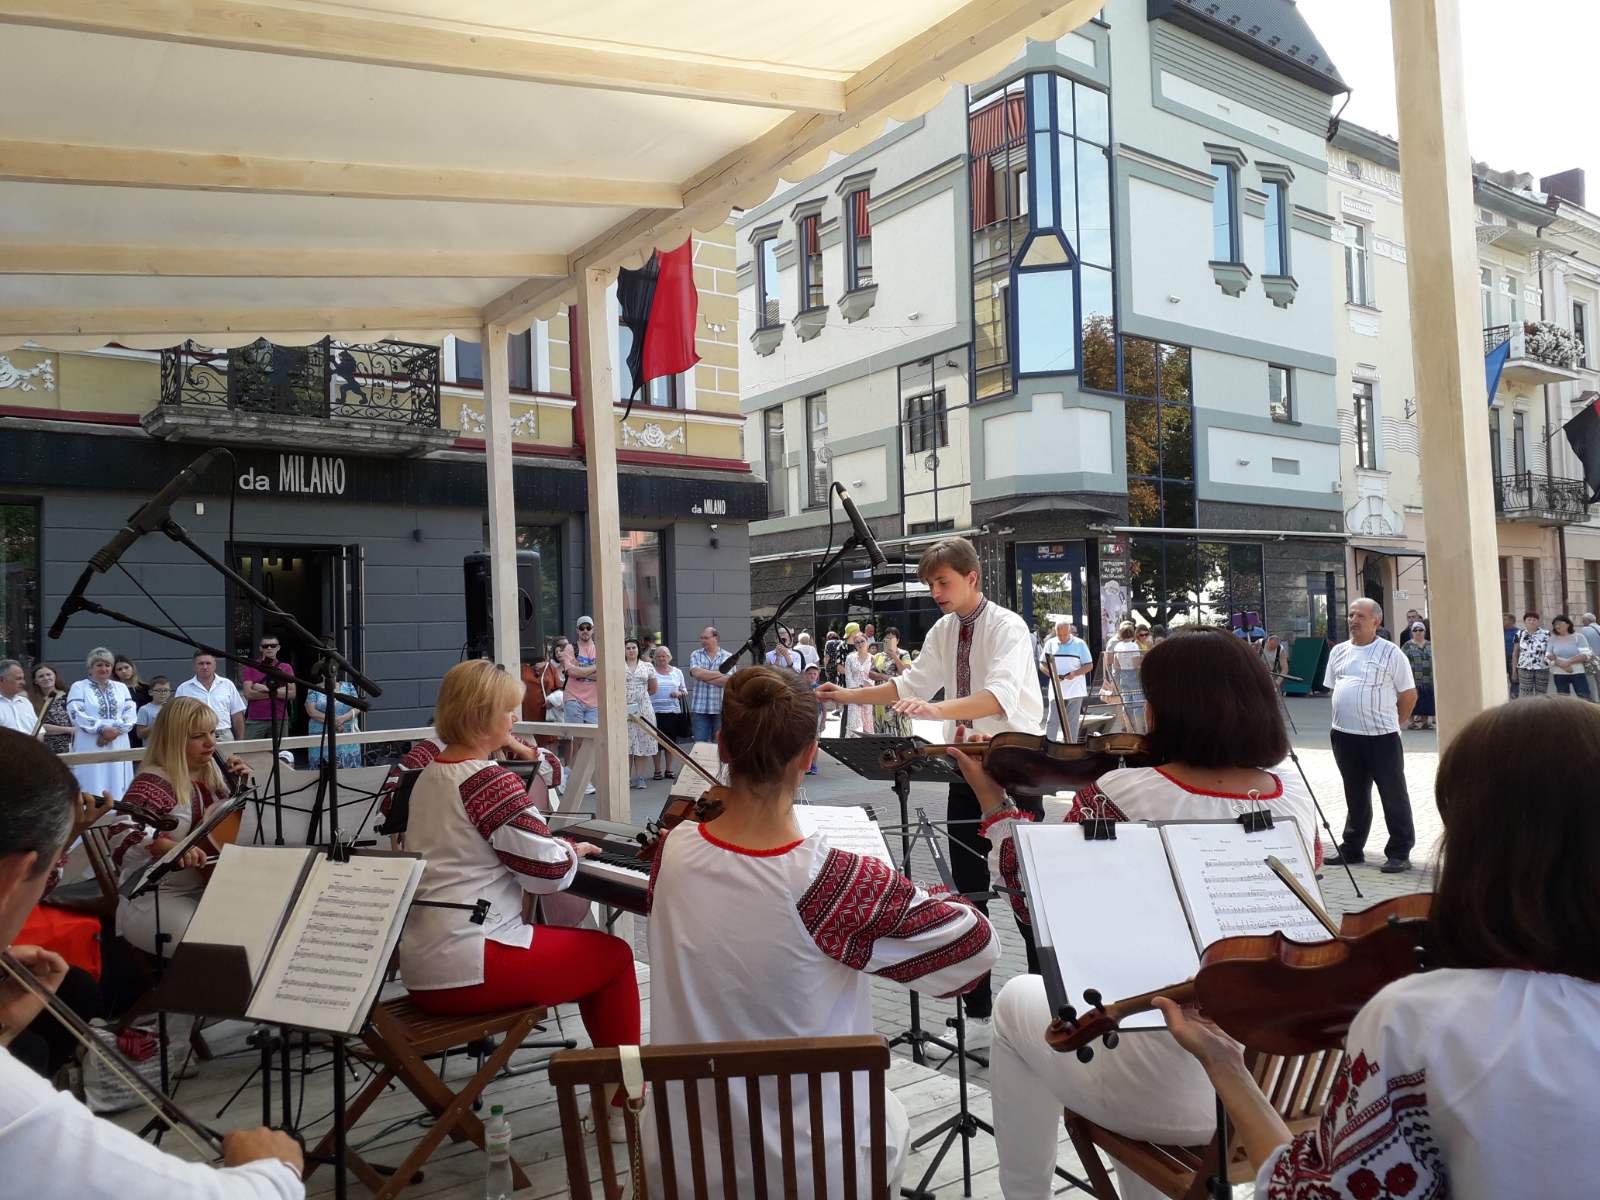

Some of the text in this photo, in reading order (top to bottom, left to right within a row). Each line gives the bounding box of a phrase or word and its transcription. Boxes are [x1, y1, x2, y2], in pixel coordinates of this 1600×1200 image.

[239, 454, 346, 494] da MILANO
[691, 499, 726, 514] da MILANO
